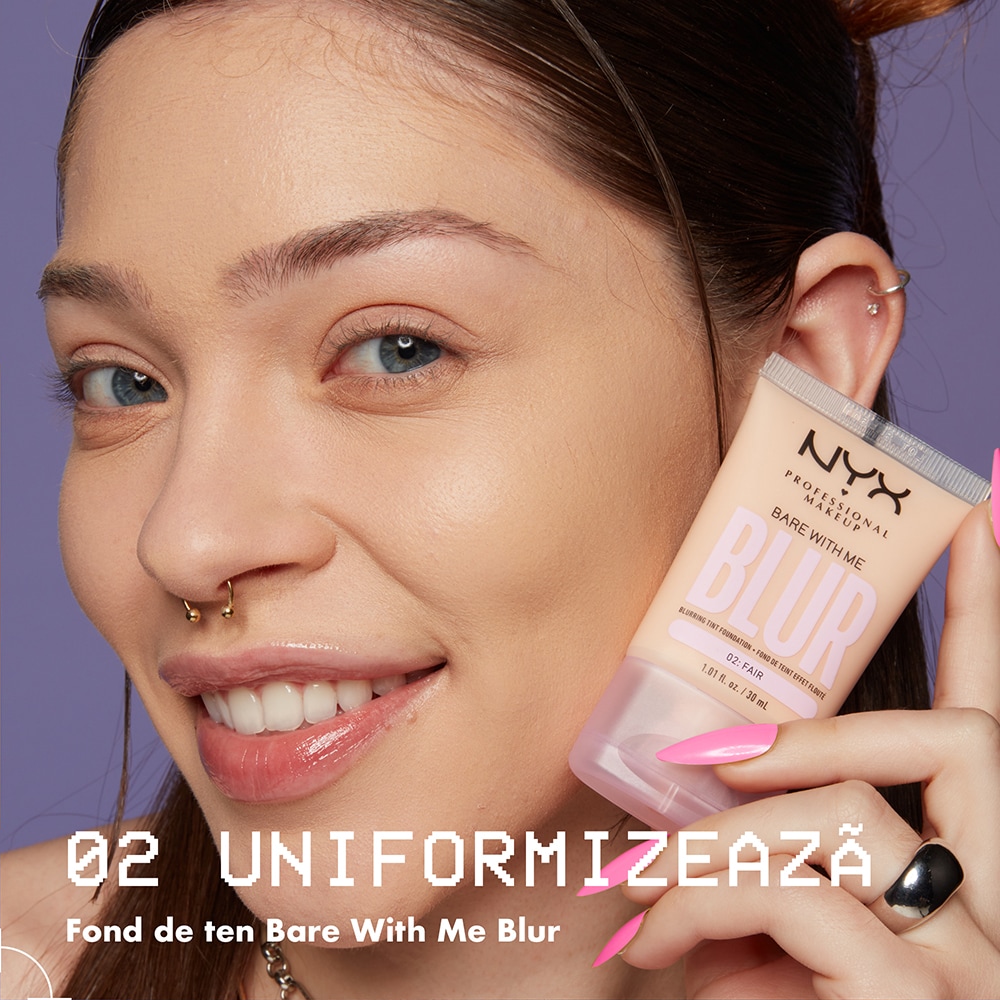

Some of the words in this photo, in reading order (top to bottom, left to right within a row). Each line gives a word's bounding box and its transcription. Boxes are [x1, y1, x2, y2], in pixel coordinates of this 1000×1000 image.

[785, 469, 889, 539] PROFESSIONAL
[798, 429, 911, 516] NYX
[771, 506, 809, 537] BARE
[809, 529, 844, 558] WITH
[843, 551, 866, 571] ME
[804, 494, 861, 532] MAKEUP
[685, 505, 878, 691] BLUR
[678, 606, 706, 624] BLURRING
[706, 620, 720, 631] TINT
[719, 626, 752, 651] FOUNDATION
[756, 649, 771, 662] FOND
[770, 657, 779, 667] DE
[778, 662, 794, 677] TEINT
[793, 672, 809, 687] EFFET
[726, 652, 741, 667] 02:
[742, 662, 765, 681] FAIR
[701, 663, 719, 679] 1.01
[718, 673, 726, 685] fl.
[728, 681, 739, 693] oz.
[746, 690, 757, 702] 30
[756, 698, 769, 711] mL
